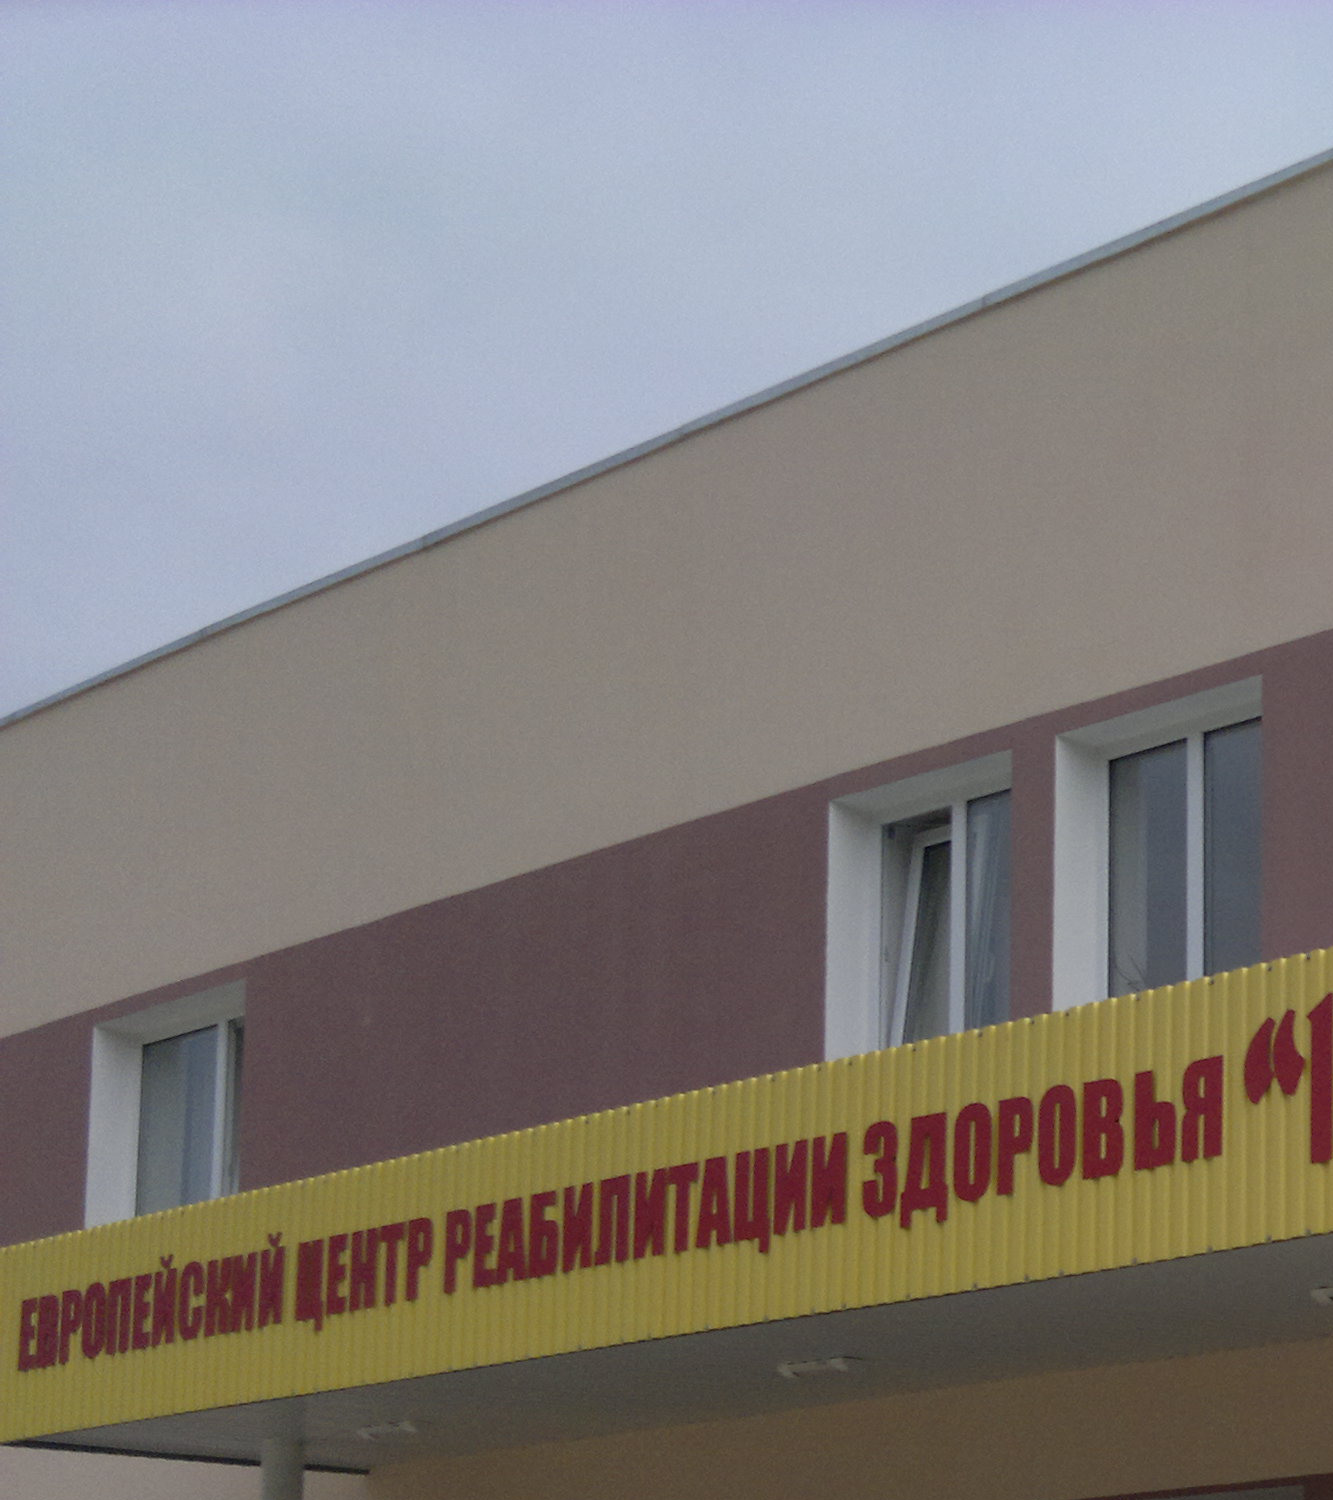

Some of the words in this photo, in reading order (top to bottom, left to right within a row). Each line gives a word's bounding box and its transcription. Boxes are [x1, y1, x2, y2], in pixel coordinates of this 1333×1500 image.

[17, 1232, 287, 1372] ЕВРОПЕЙСКИЙ
[294, 1216, 433, 1333] ЦЕНТР
[443, 1131, 849, 1295] РЕАБИЛИТАЦИИ
[861, 1055, 1224, 1229] ЗДОРОВЬЯ
